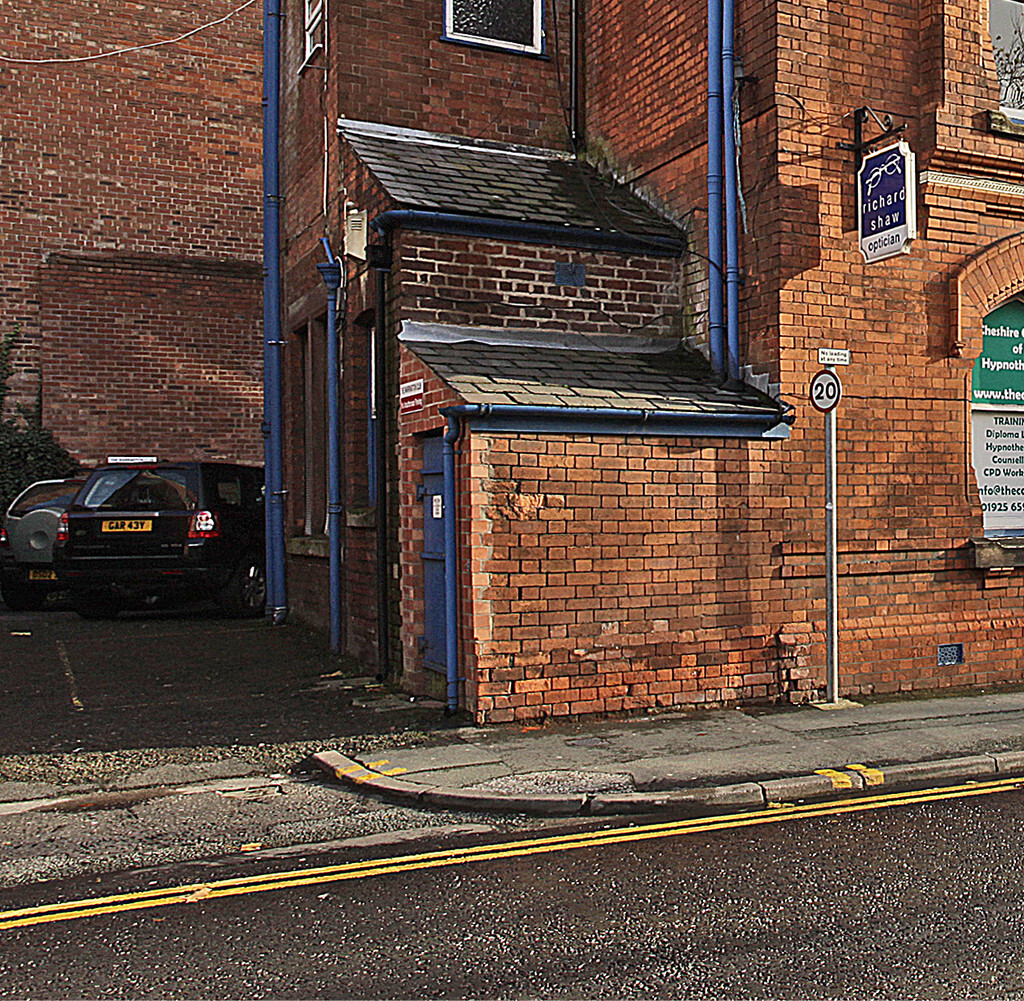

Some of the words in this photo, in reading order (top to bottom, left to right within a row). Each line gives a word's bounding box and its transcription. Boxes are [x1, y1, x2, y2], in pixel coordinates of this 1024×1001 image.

[863, 187, 905, 214] richard
[870, 212, 900, 231] shaw
[868, 233, 900, 253] optician
[1012, 343, 1023, 354] of
[814, 382, 836, 400] 20
[986, 429, 1019, 439] Diploma
[983, 468, 1001, 477] CPD
[981, 502, 1008, 511] 01925
[127, 520, 146, 530] 43Y
